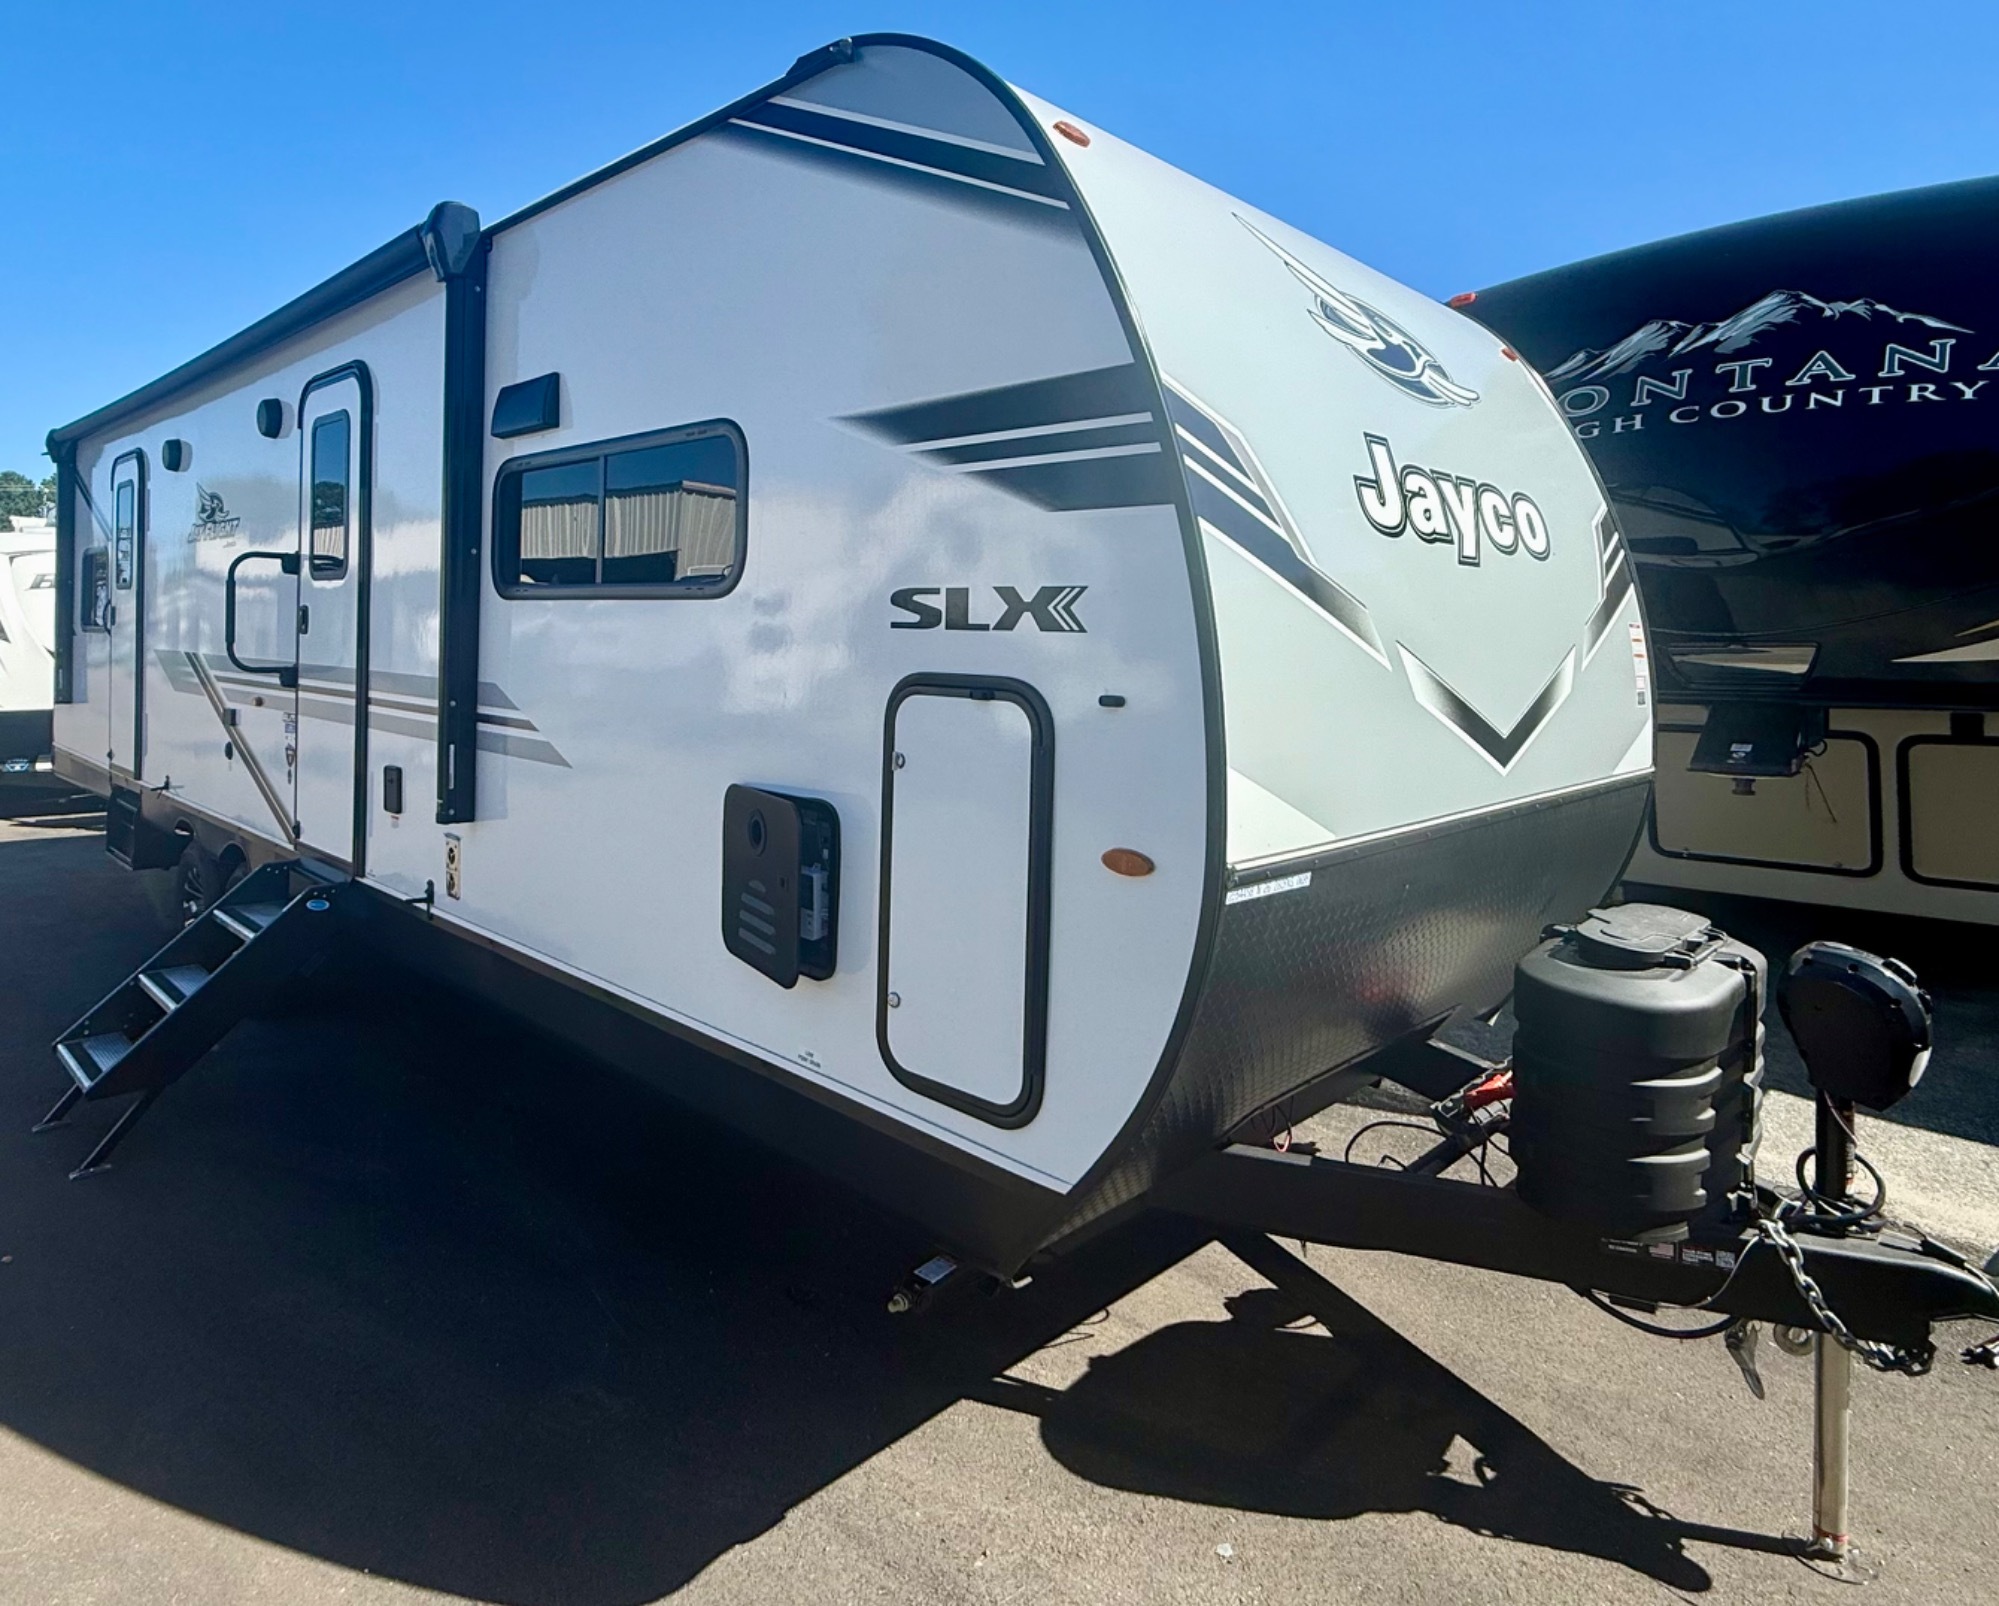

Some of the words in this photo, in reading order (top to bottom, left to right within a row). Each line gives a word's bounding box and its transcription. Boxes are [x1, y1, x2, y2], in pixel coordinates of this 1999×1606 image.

[1557, 337, 1999, 418] ONTAN
[1574, 412, 1645, 440] GH
[1669, 379, 1990, 425] COUNTRY
[1353, 431, 1550, 568] Jayco
[890, 585, 1088, 633] SLX
